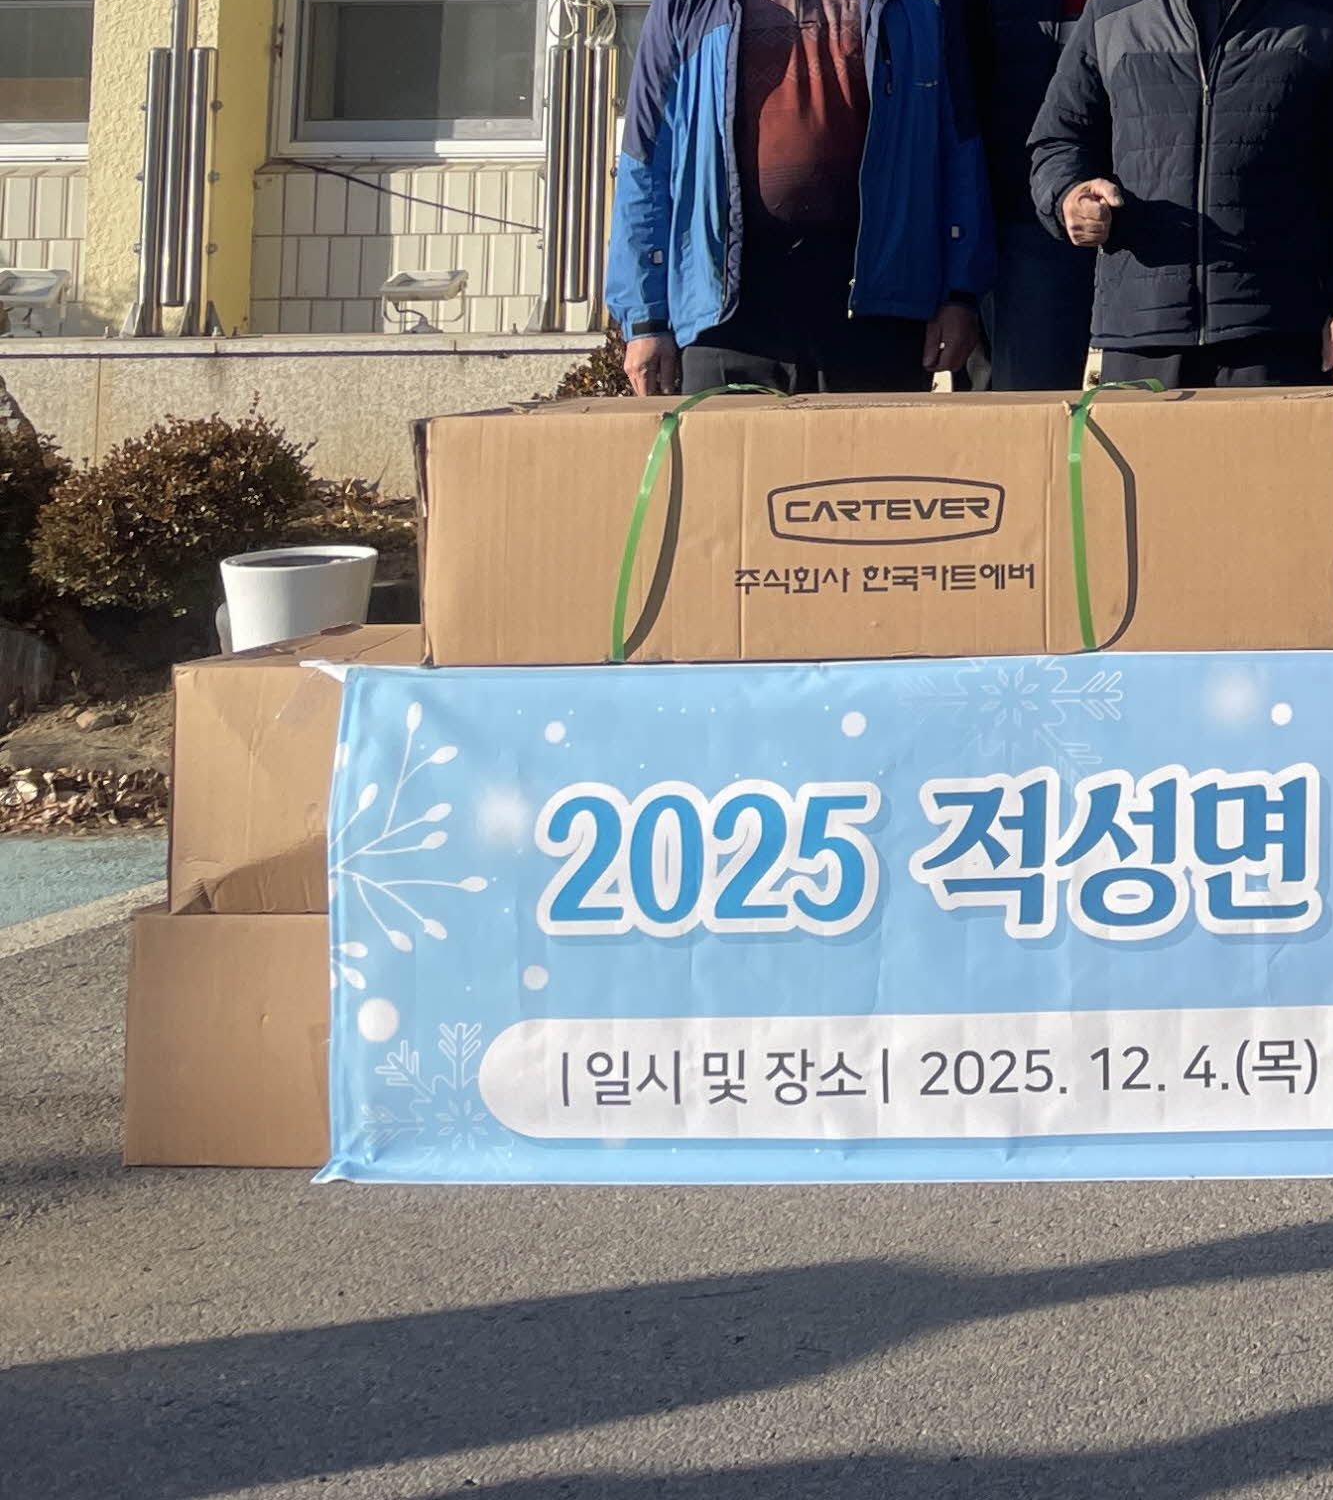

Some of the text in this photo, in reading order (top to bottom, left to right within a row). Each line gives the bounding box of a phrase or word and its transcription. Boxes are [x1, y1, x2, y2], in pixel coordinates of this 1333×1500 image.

[785, 496, 991, 523] CARTEVER
[734, 563, 1036, 595] 주식회사 한국카트에버
[545, 794, 873, 927] 2025
[922, 784, 1315, 924] 적성면
[703, 1049, 748, 1105] 및
[920, 1049, 1067, 1096] 2025.
[1090, 1046, 1165, 1092] 12.
